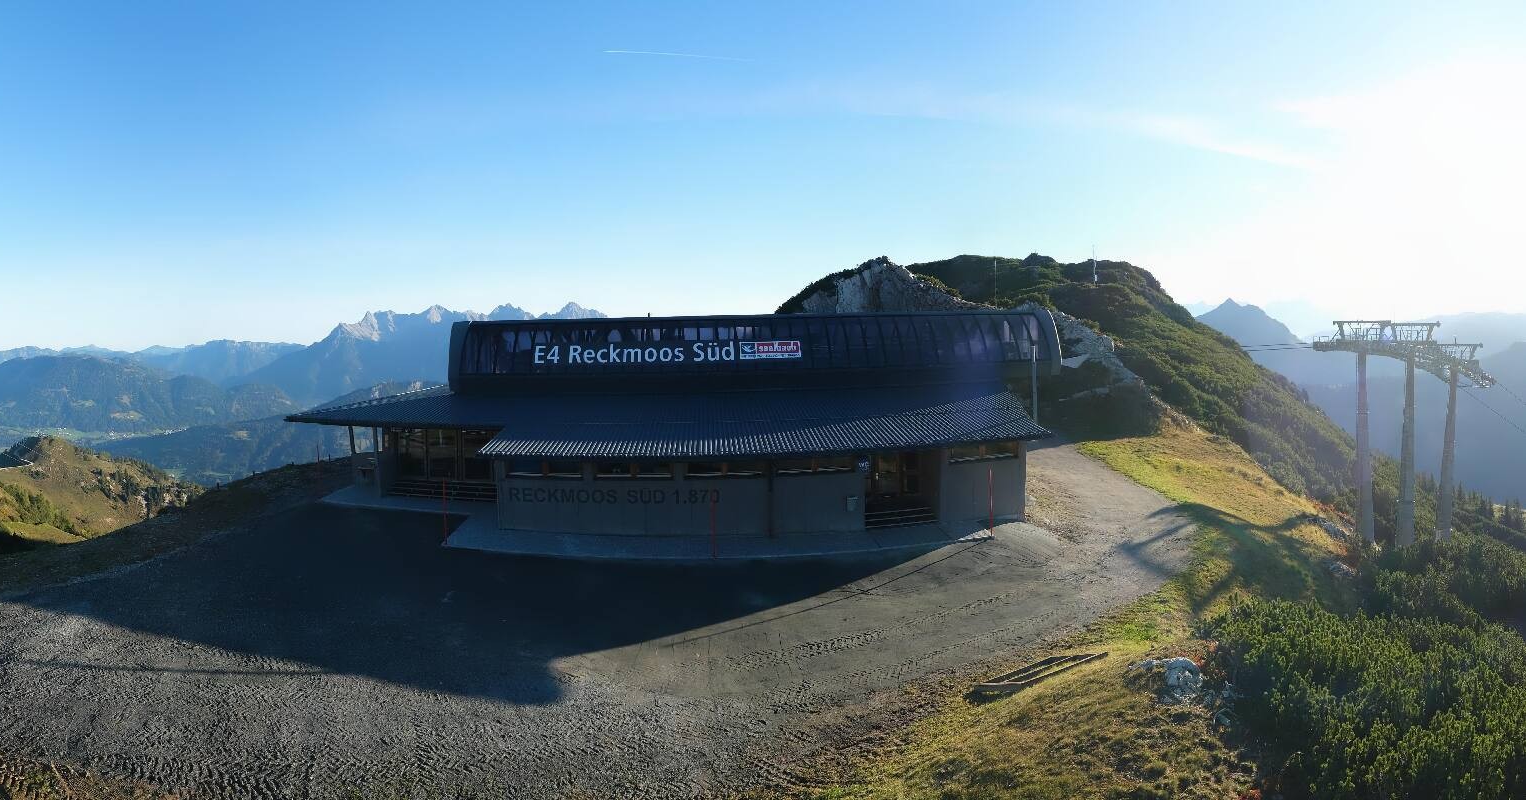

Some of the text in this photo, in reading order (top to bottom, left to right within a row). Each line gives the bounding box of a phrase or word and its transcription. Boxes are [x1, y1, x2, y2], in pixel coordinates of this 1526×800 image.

[534, 341, 735, 364] E4 Reckmoos Süd
[509, 487, 618, 504] RECKMOOS
[672, 488, 721, 505] 1.870
